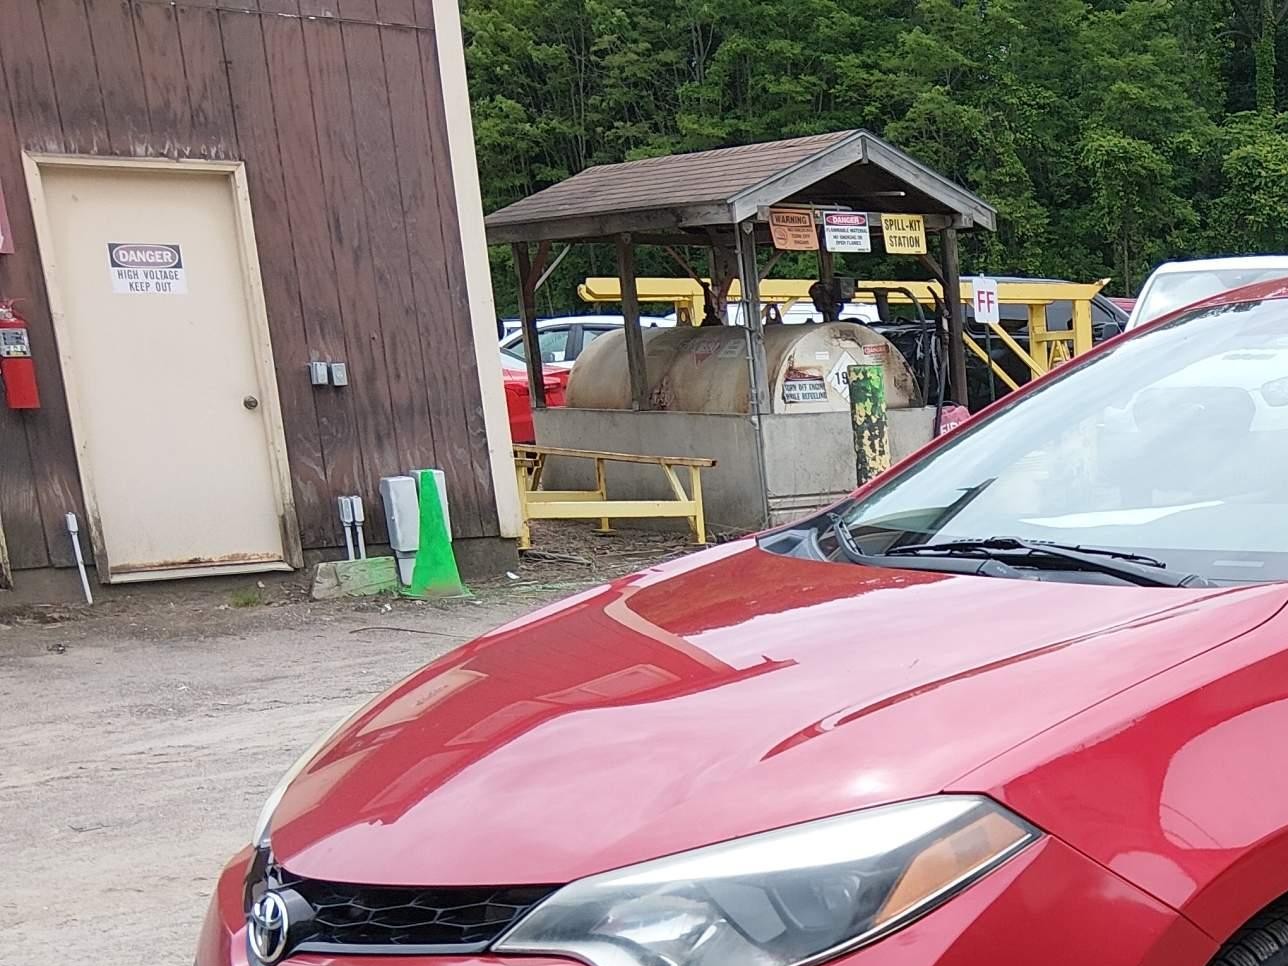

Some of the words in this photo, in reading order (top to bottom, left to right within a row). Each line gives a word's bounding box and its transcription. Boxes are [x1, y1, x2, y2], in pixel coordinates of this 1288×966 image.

[774, 215, 807, 224] WARNING
[884, 219, 921, 231] SPILL-KIT
[889, 235, 920, 248] STATION
[119, 250, 173, 262] DANGER
[117, 270, 139, 280] HIGH
[143, 270, 180, 280] VOLTAGE
[129, 281, 151, 292] KEEP
[155, 281, 172, 292] OUT
[977, 290, 994, 313] FF
